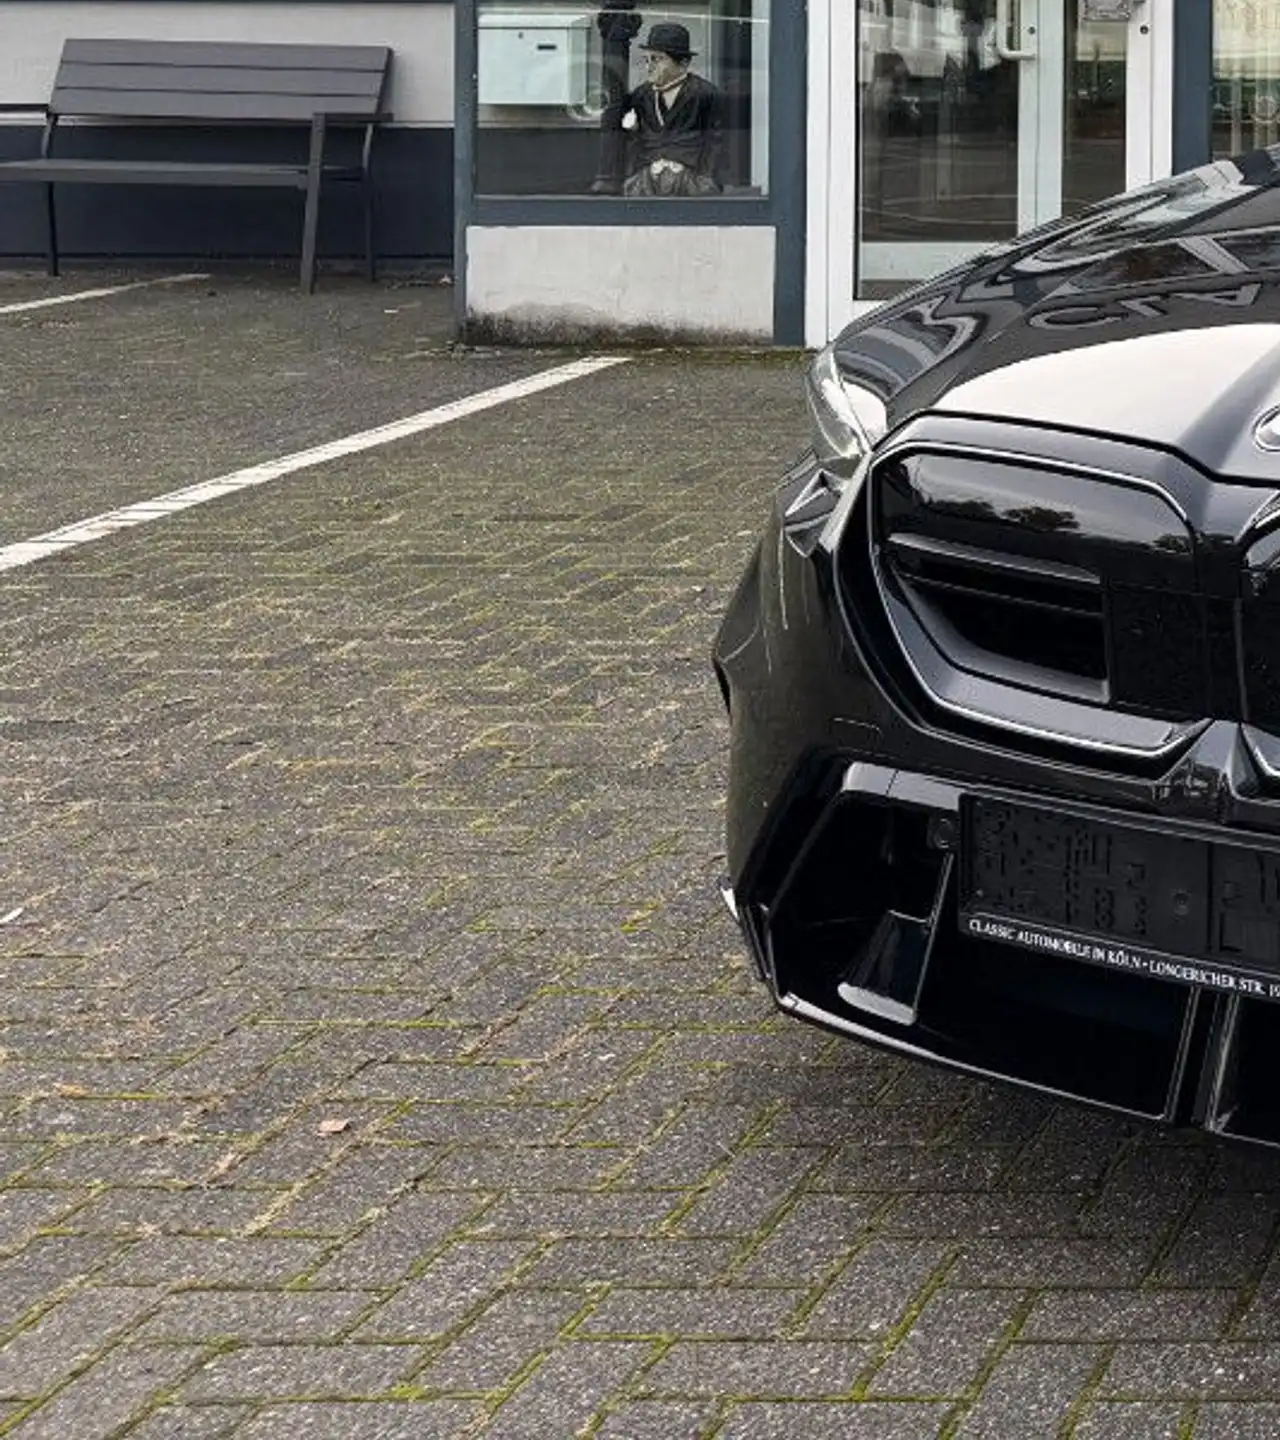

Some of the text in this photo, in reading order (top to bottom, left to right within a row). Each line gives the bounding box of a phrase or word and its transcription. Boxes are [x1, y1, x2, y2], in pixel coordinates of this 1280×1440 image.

[969, 919, 1016, 941] CLASSIC
[1016, 931, 1090, 957] AUTOMOBILE
[1107, 950, 1141, 969] KÖLN
